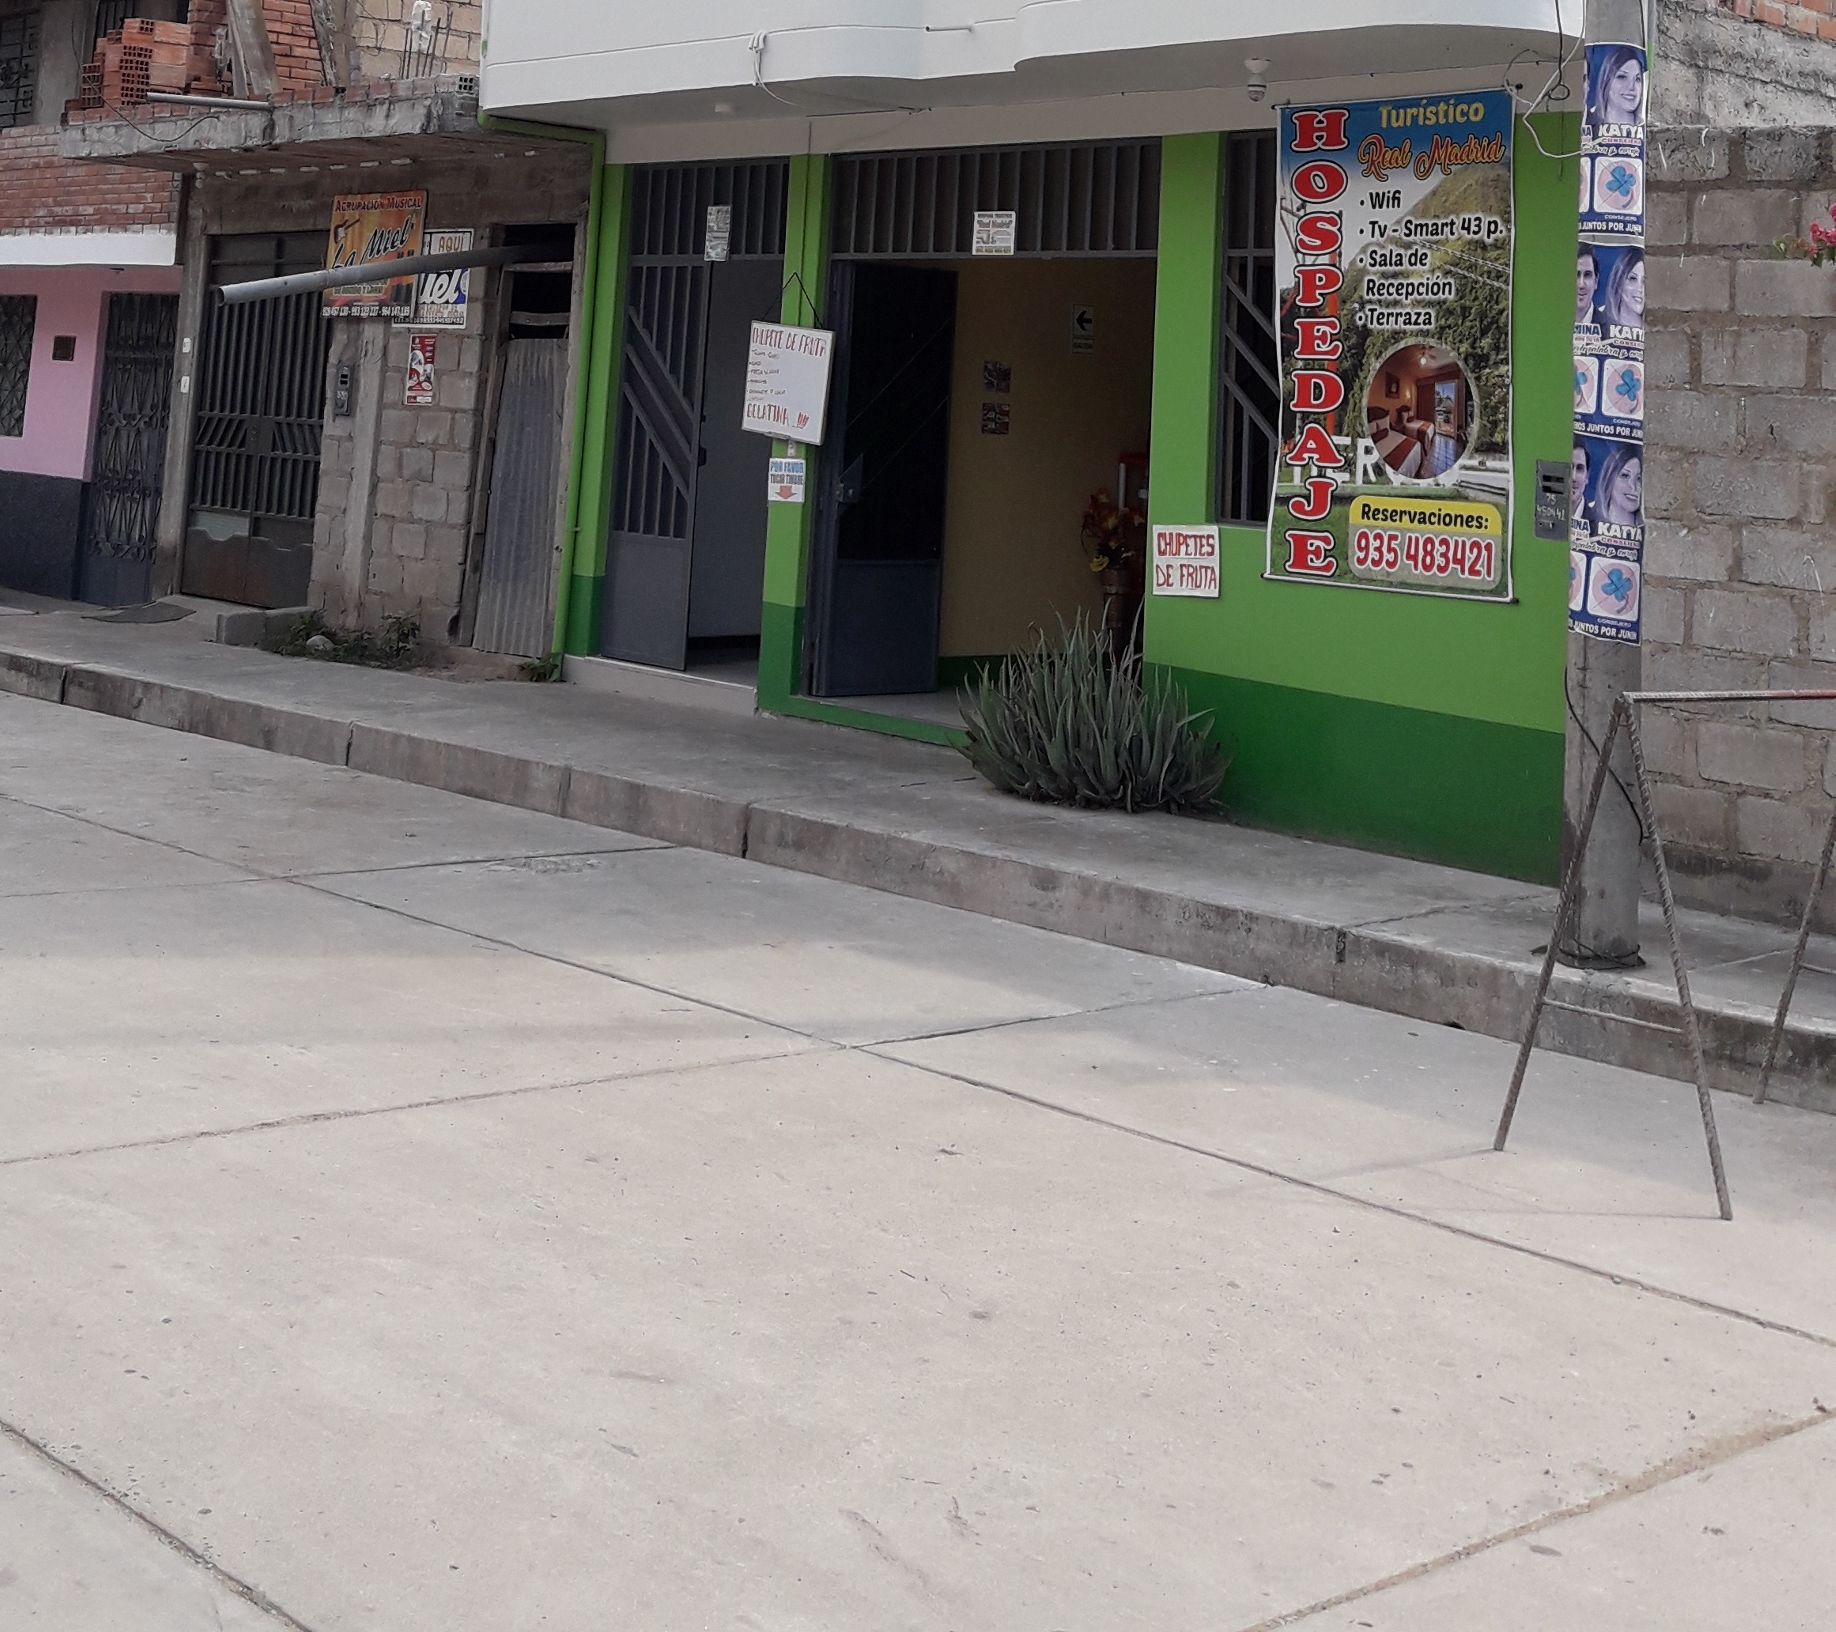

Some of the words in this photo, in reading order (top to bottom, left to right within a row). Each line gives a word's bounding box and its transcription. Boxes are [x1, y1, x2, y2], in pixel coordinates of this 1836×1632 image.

[1379, 100, 1485, 129] Turístico
[1598, 124, 1643, 139] KATYA
[1358, 134, 1412, 182] Real
[1414, 131, 1506, 181] Madrid
[1369, 190, 1401, 209] Wifi
[1369, 220, 1388, 239] Tv
[1403, 218, 1457, 238] Smart
[1461, 217, 1482, 236] 43
[1486, 219, 1504, 241] p.
[1608, 222, 1624, 231] POR
[1368, 249, 1404, 268] Sala
[1408, 248, 1428, 267] de
[1366, 275, 1453, 300] Recepción
[1368, 308, 1433, 326] Terraza
[786, 331, 798, 351] DE
[1284, 107, 1350, 578] HOSPEDAJE
[1587, 423, 1614, 434] JUNTOS
[1616, 425, 1631, 436] POR
[1361, 503, 1489, 530] Reservaciones:
[1597, 521, 1643, 542] KATYA
[1157, 532, 1215, 556] CHUPETES
[1355, 529, 1402, 571] 935
[1404, 533, 1495, 580] 483421
[1156, 564, 1173, 587] DE
[1179, 564, 1217, 589] FRUTA
[1600, 625, 1616, 636] POR
